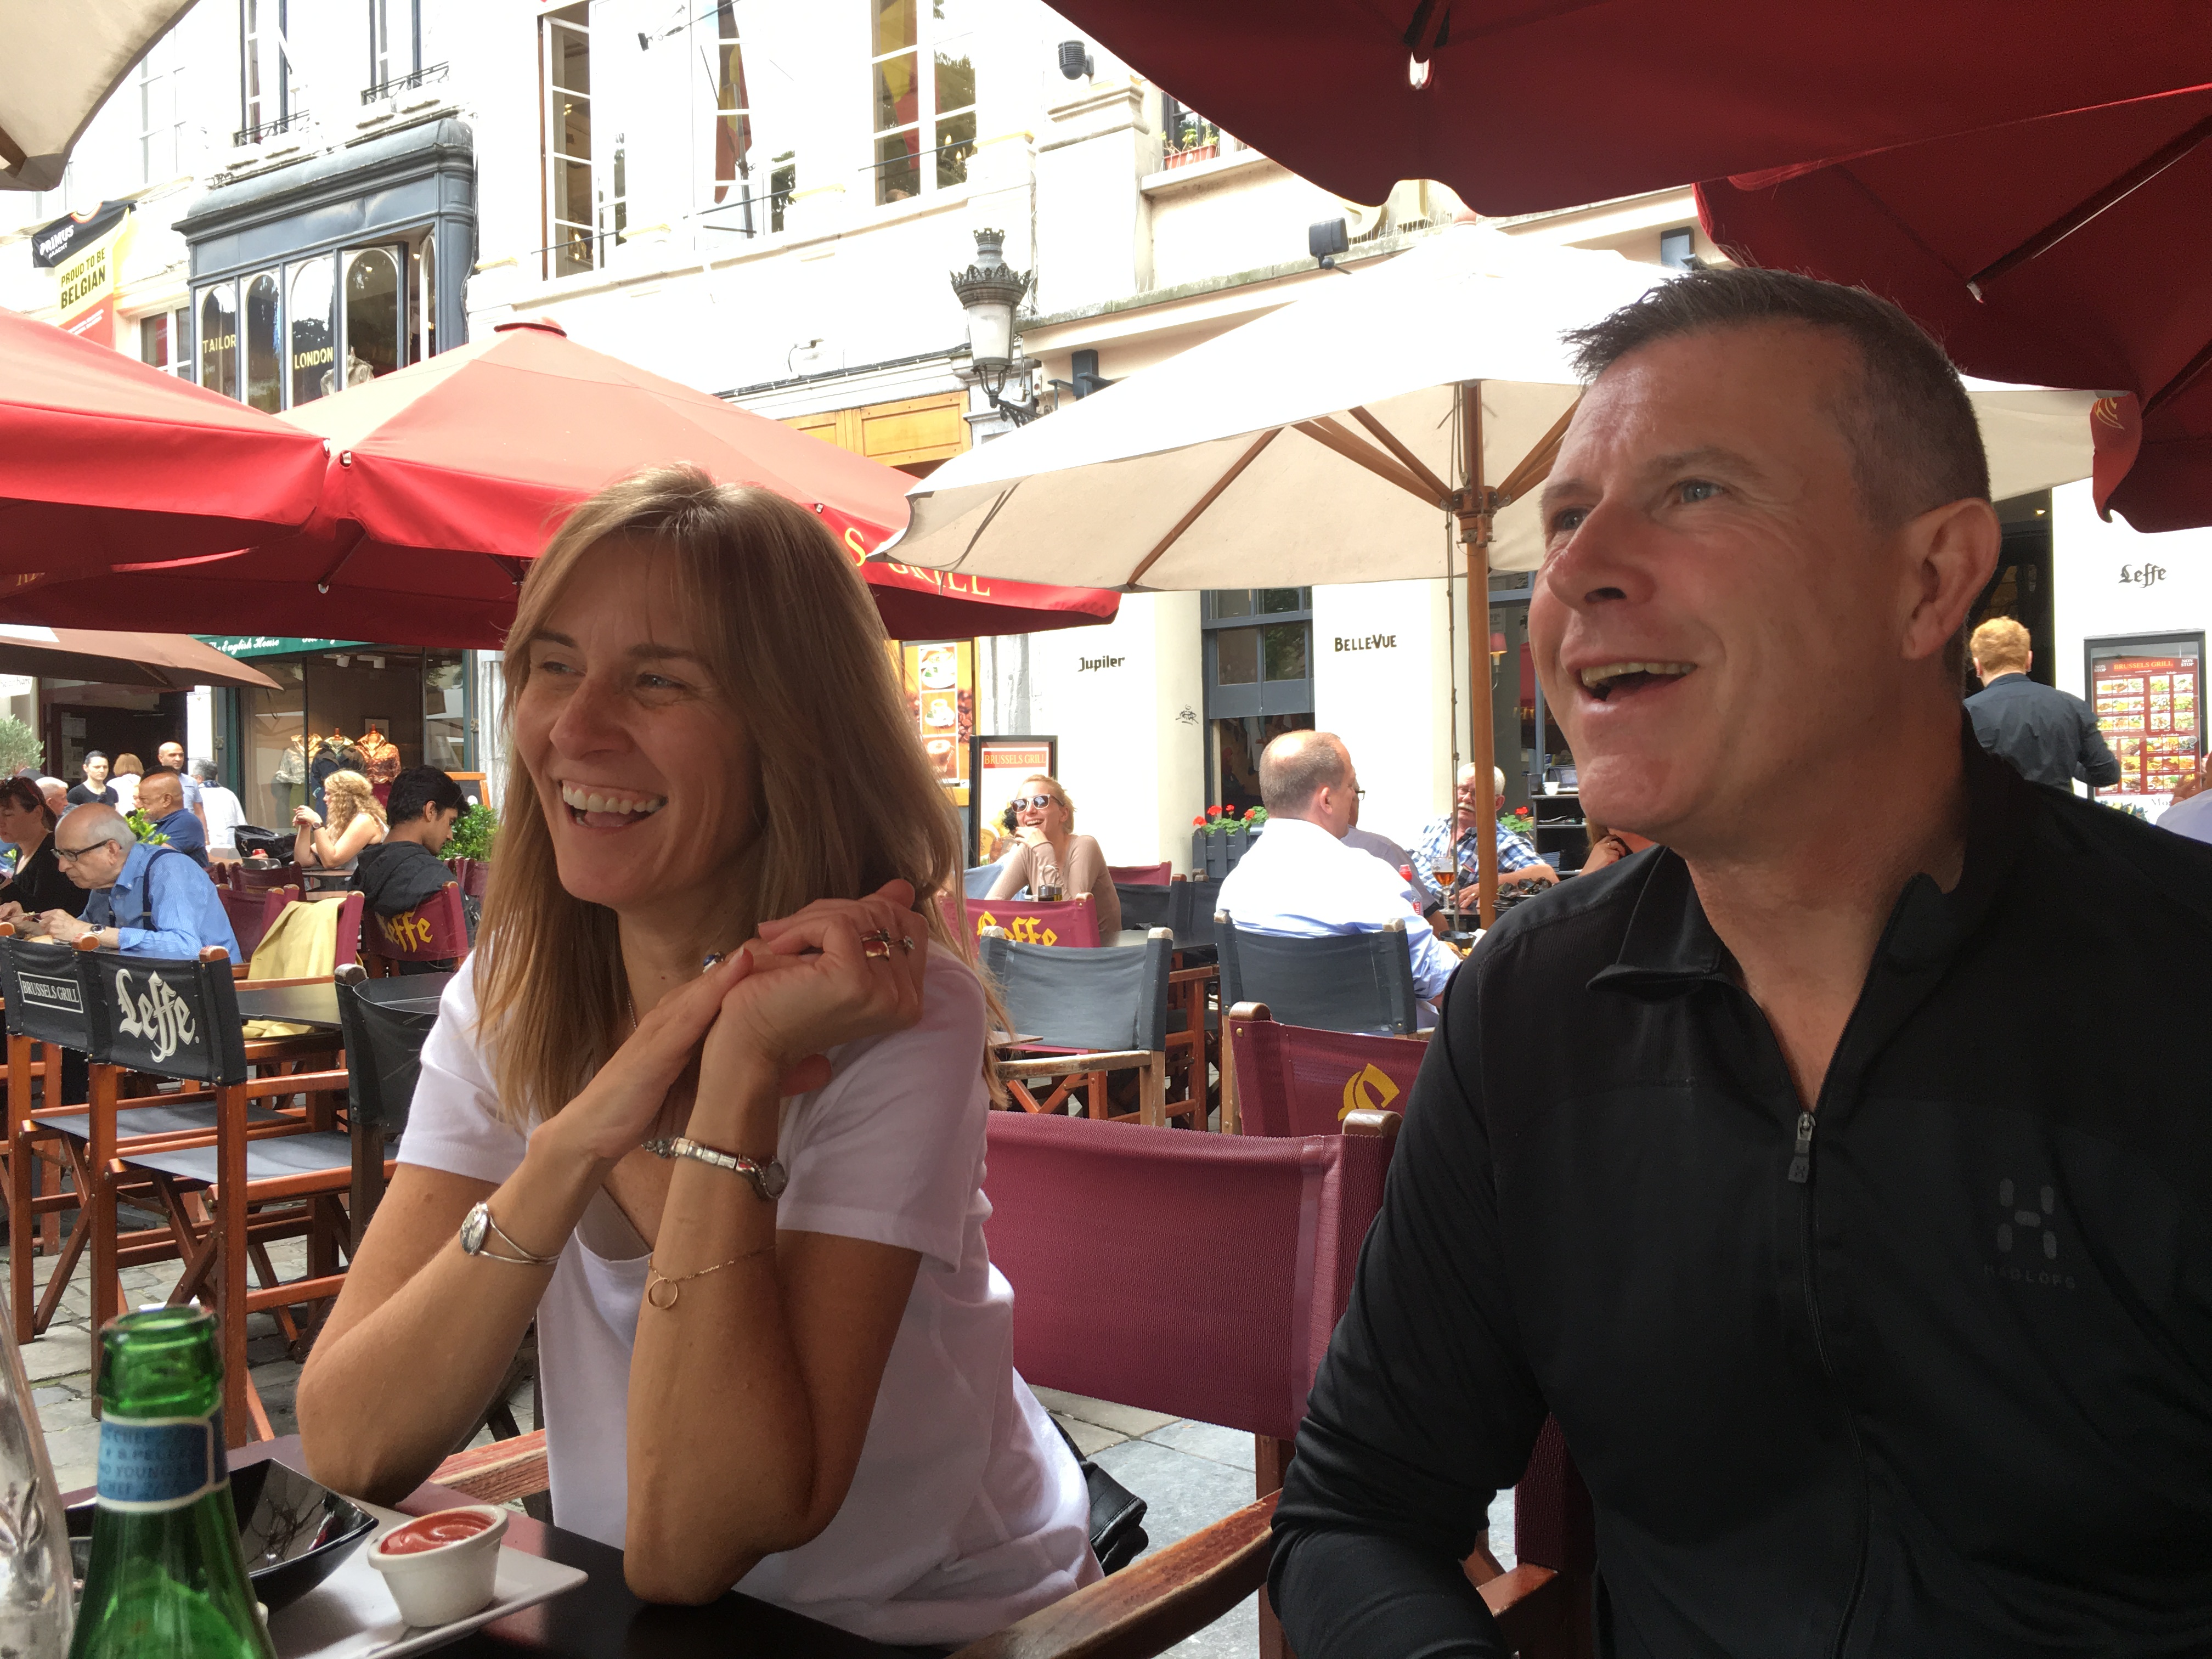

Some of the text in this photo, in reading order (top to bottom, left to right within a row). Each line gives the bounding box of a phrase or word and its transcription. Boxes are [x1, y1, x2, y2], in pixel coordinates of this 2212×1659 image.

[40, 225, 74, 255] PRIMUS
[61, 247, 105, 287] PROUD TO BE
[61, 265, 105, 309] BELGIAN
[202, 335, 236, 353] TAILOR
[295, 347, 333, 369] LONDON
[2118, 563, 2167, 588] Leffe
[222, 638, 251, 655] English
[253, 636, 280, 647] House
[1077, 655, 1125, 672] Jupiler
[984, 754, 1046, 764] BRUSSELS GRILL
[21, 980, 80, 1003] BRUSSELS GRILL
